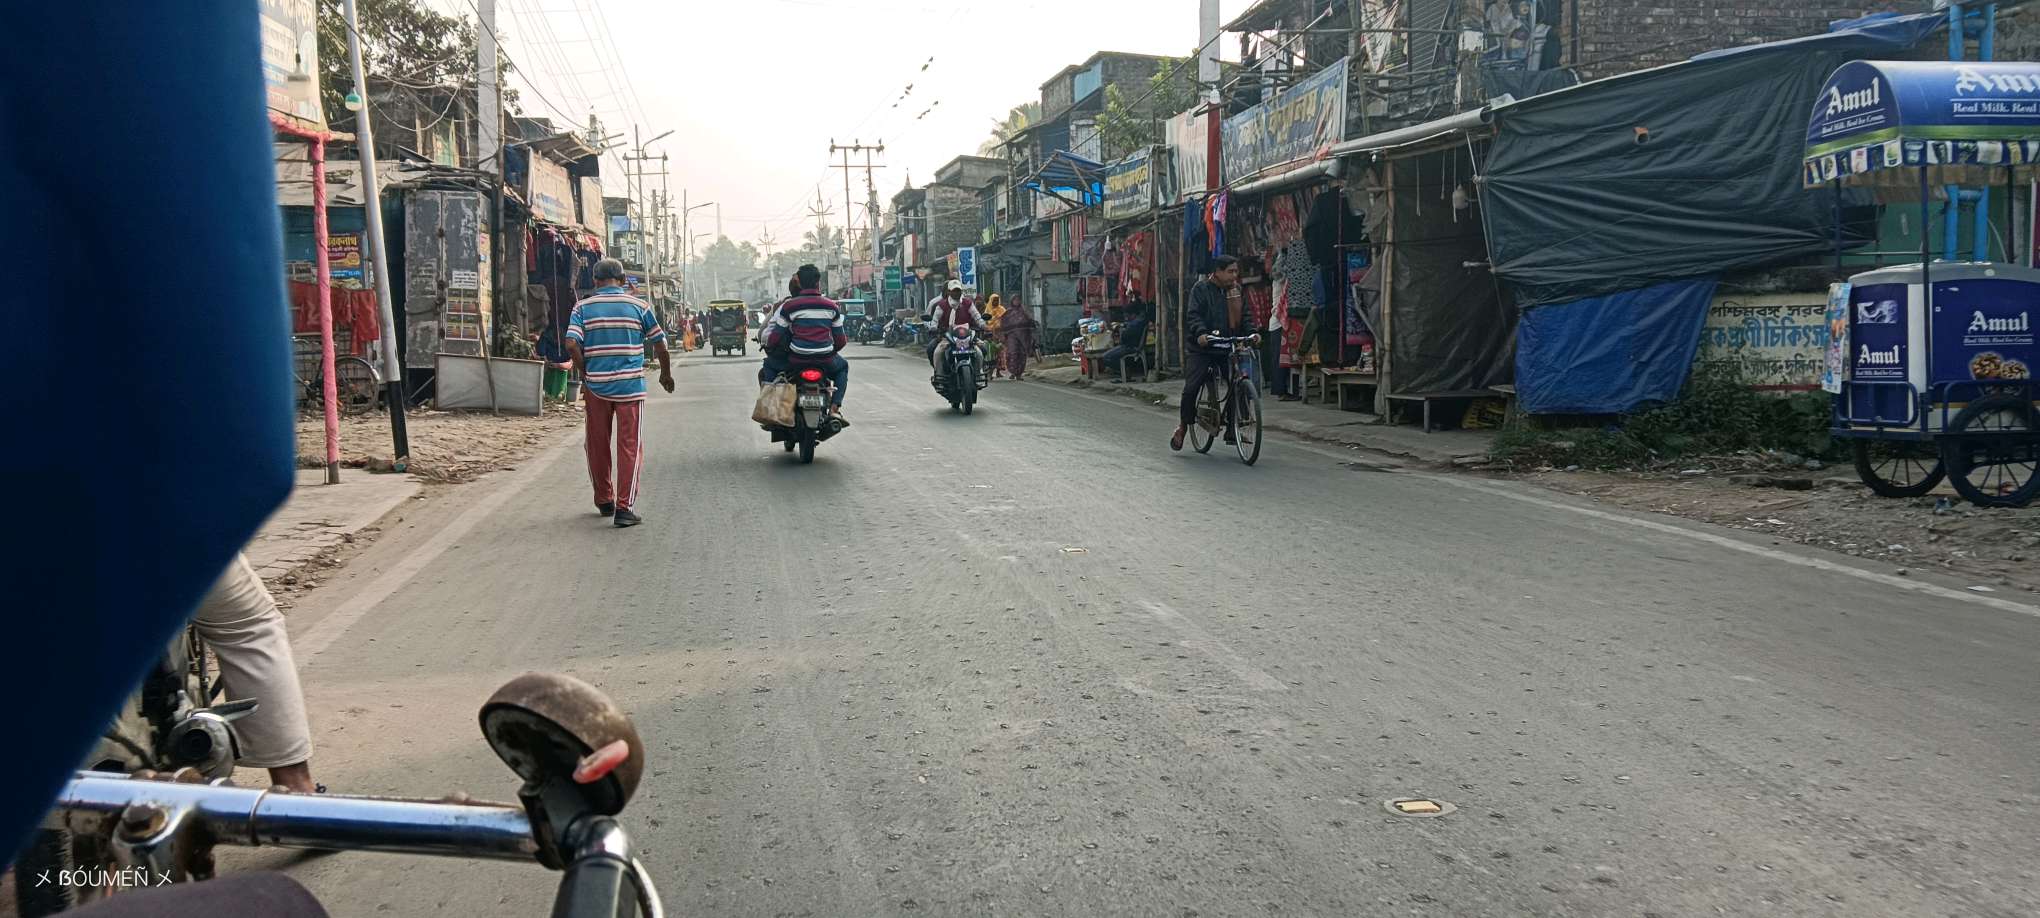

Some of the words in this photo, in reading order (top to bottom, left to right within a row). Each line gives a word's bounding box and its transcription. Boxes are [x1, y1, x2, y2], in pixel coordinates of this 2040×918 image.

[1825, 76, 1880, 121] Amul
[1711, 300, 1783, 319] পশ্চিমবঙ্গ
[1786, 304, 1826, 318] সরক
[1764, 316, 1828, 349] চিকিৎস
[1967, 310, 2029, 335] Amul
[1858, 344, 1900, 367] Amul
